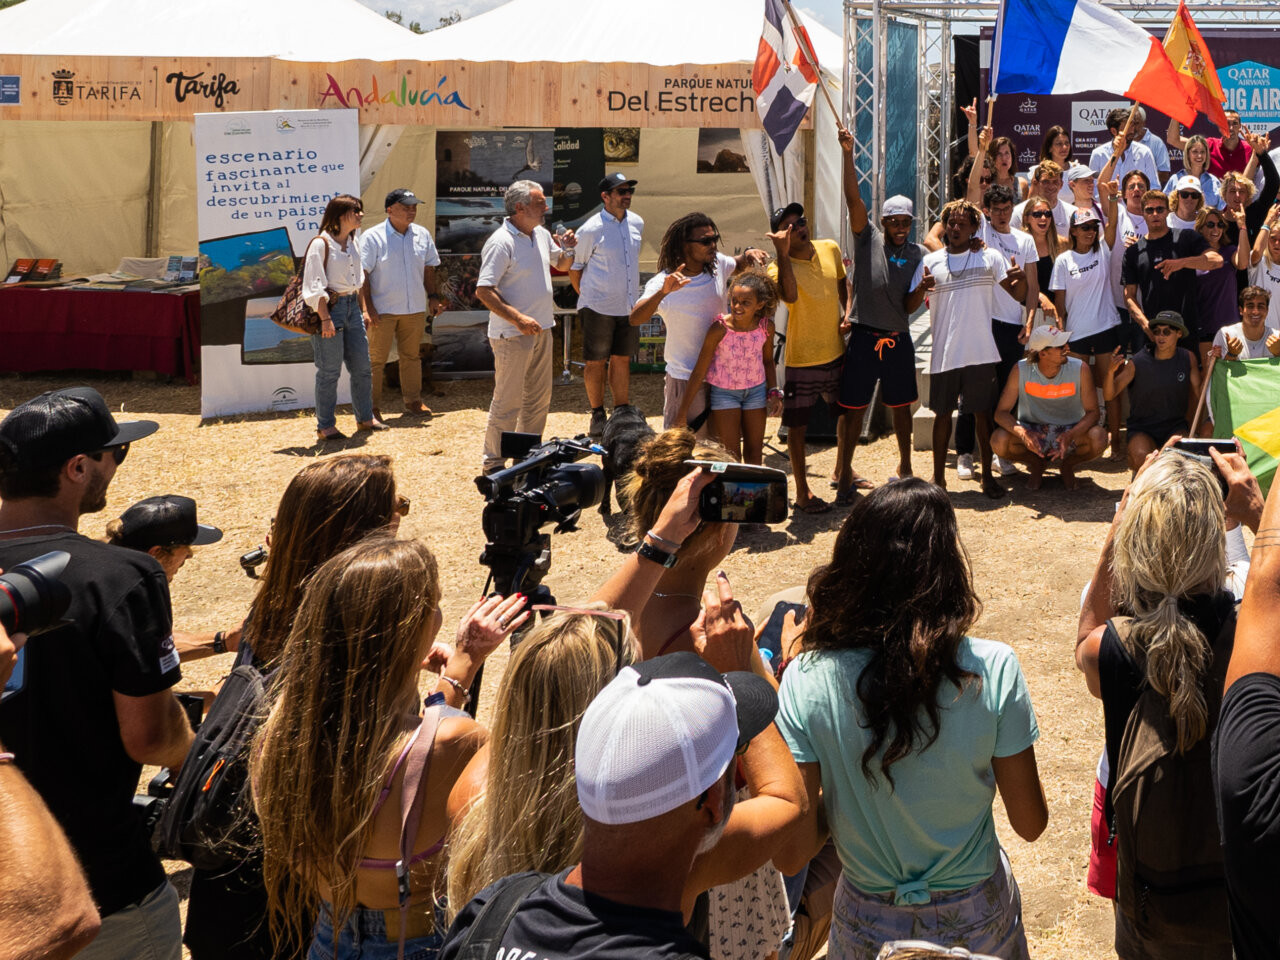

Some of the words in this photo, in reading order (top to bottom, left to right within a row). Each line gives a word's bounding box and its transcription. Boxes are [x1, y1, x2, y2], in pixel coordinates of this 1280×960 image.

[1228, 68, 1270, 81] QATAR
[166, 71, 241, 108] Tarifa
[664, 78, 713, 90] PARQUE
[76, 86, 142, 100] TARIFA
[319, 73, 472, 111] Andalucía
[1250, 88, 1280, 111] AIR
[608, 90, 650, 112] Del
[658, 91, 754, 113] Estrech
[1014, 124, 1041, 133] QATAR
[205, 148, 318, 165] escenario
[205, 162, 318, 182] fascinante
[321, 163, 345, 174] que
[212, 180, 271, 193] invita
[276, 179, 291, 189] al
[231, 210, 249, 220] de
[254, 210, 273, 219] un
